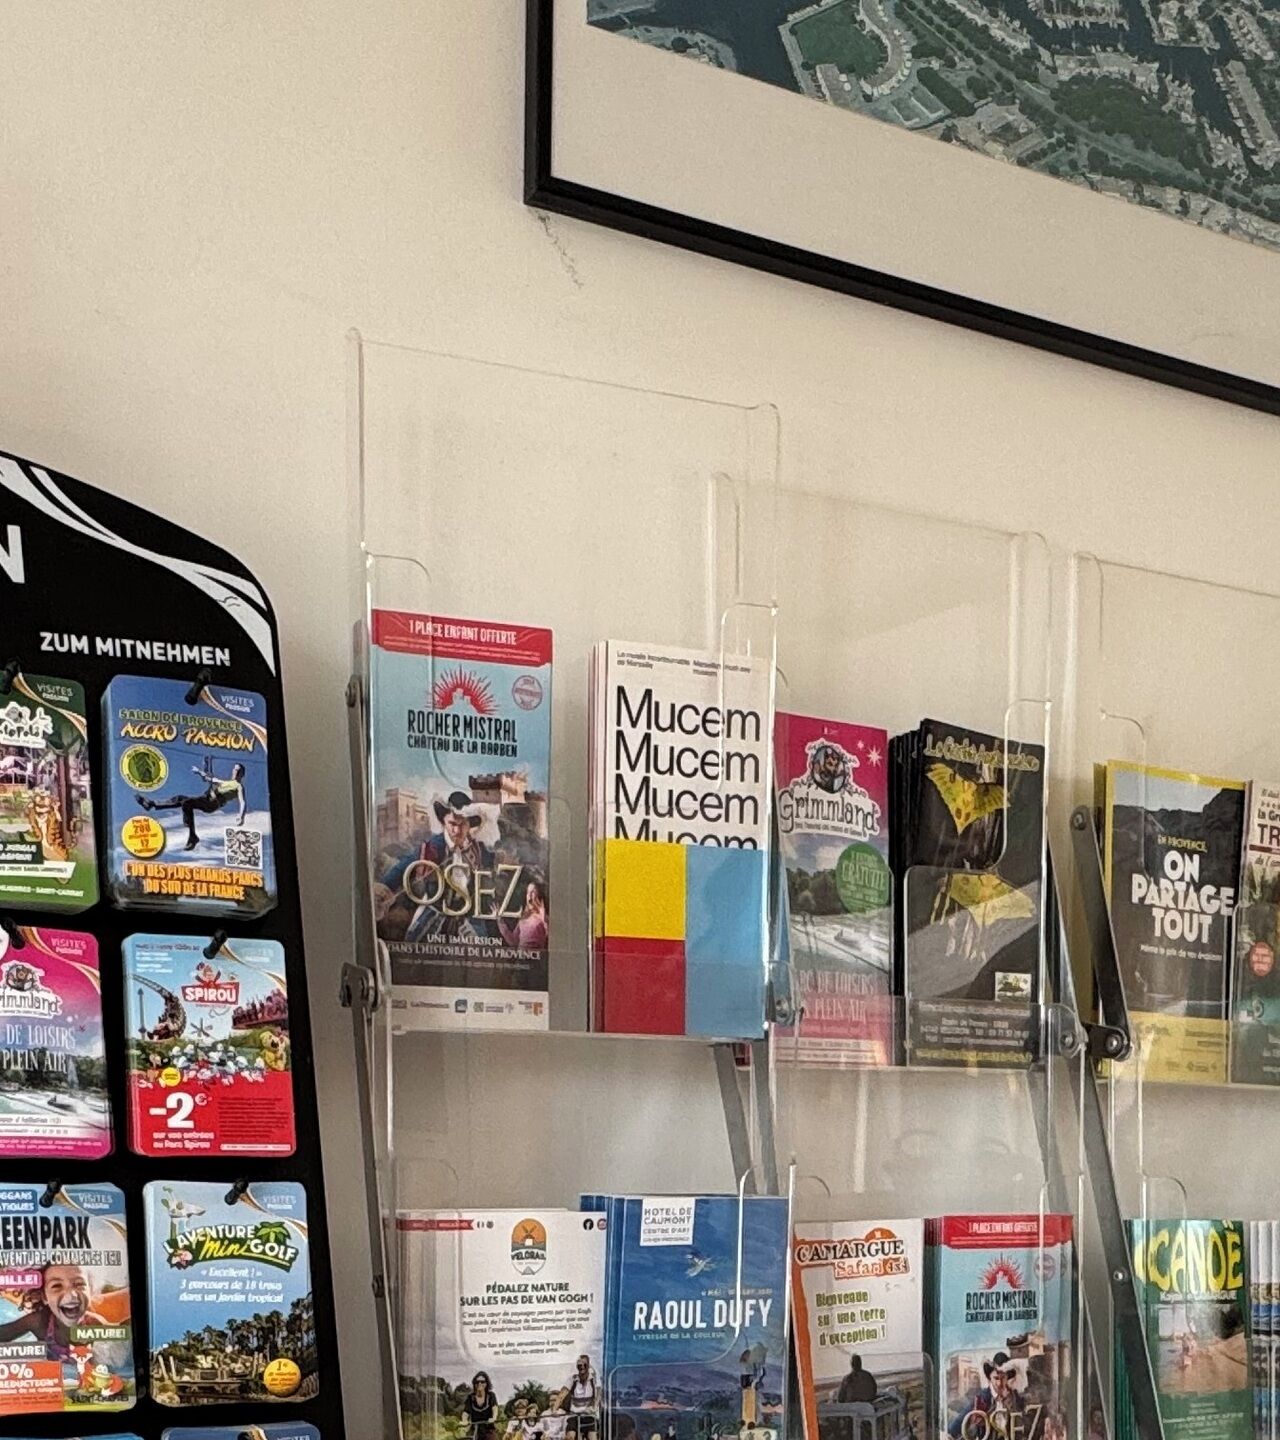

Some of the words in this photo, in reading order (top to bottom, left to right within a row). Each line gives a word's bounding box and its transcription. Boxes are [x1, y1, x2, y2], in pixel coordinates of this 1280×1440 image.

[39, 631, 90, 655] ZUM
[94, 636, 232, 667] MITNEHMEN
[406, 708, 461, 738] ROCHER
[462, 712, 519, 745] MISTRAL
[614, 684, 762, 743] Mucem
[406, 732, 452, 753] CHÂTEAU
[452, 738, 464, 754] DE
[465, 739, 479, 756] LA
[480, 739, 519, 759] BARBEN
[614, 728, 761, 784] Mucem
[613, 772, 761, 826] Mucem
[777, 787, 881, 836] Grimmland
[1162, 849, 1202, 884] ON
[401, 857, 526, 921] OSEZ
[1130, 872, 1235, 917] PARTAGE
[1150, 906, 1214, 944] TOUT
[183, 985, 237, 1004] SPIROU
[796, 1238, 905, 1265] CAMARGUE
[1148, 1219, 1245, 1294] CANOË
[459, 1294, 482, 1307] SUR
[481, 1294, 501, 1307] LES
[500, 1294, 520, 1306] PAS
[520, 1294, 535, 1306] DE
[535, 1293, 557, 1305] VAN
[557, 1292, 588, 1305] GOGH
[484, 1281, 530, 1295] PÉDALEZ
[530, 1281, 571, 1294] NATURE
[965, 1290, 1001, 1311] ROCHER
[1001, 1289, 1038, 1310] MISTRAL
[632, 1300, 708, 1331] RAOUL
[713, 1298, 774, 1330] DUFY
[76, 1327, 127, 1340] NATURE!
